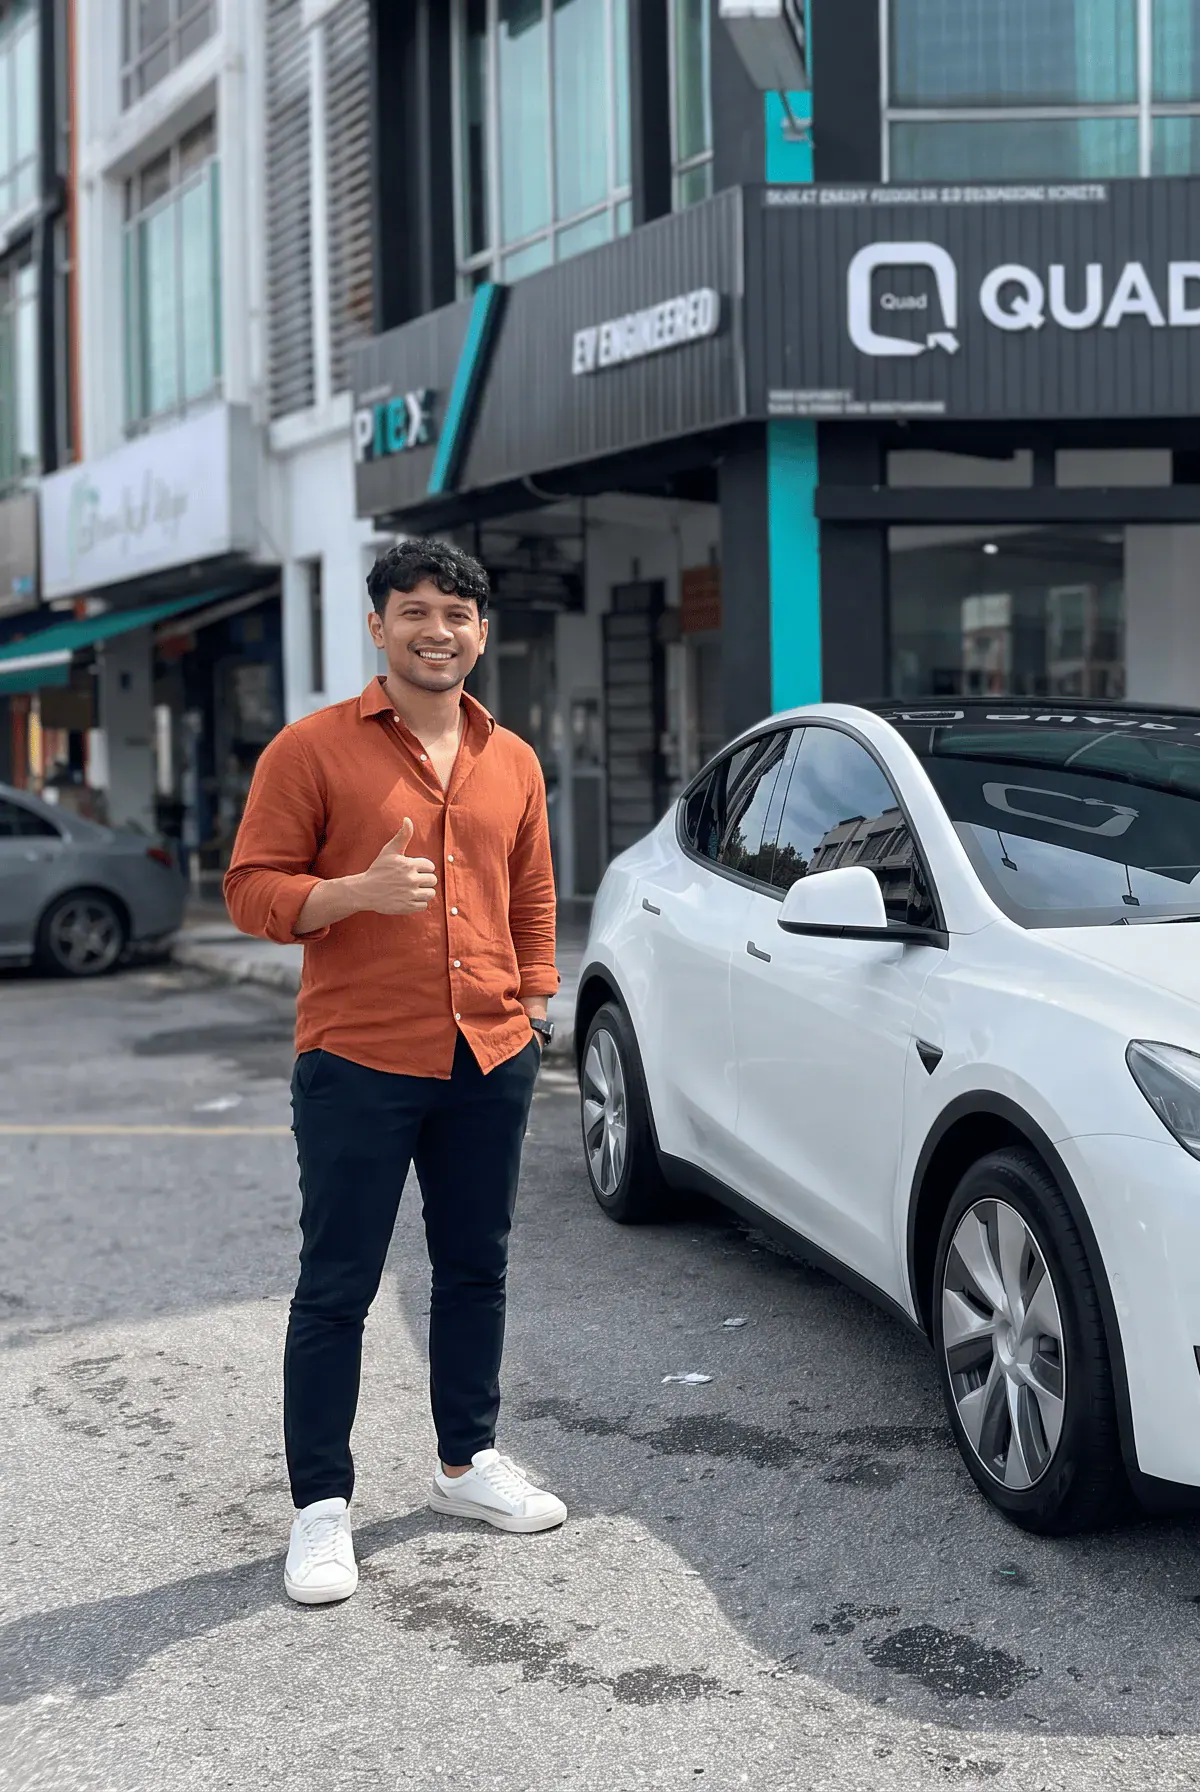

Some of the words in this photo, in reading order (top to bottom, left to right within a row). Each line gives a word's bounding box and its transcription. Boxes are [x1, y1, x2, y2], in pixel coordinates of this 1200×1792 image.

[880, 293, 928, 310] Quad
[572, 327, 598, 375] EV
[599, 287, 721, 367] ENGINEERED
